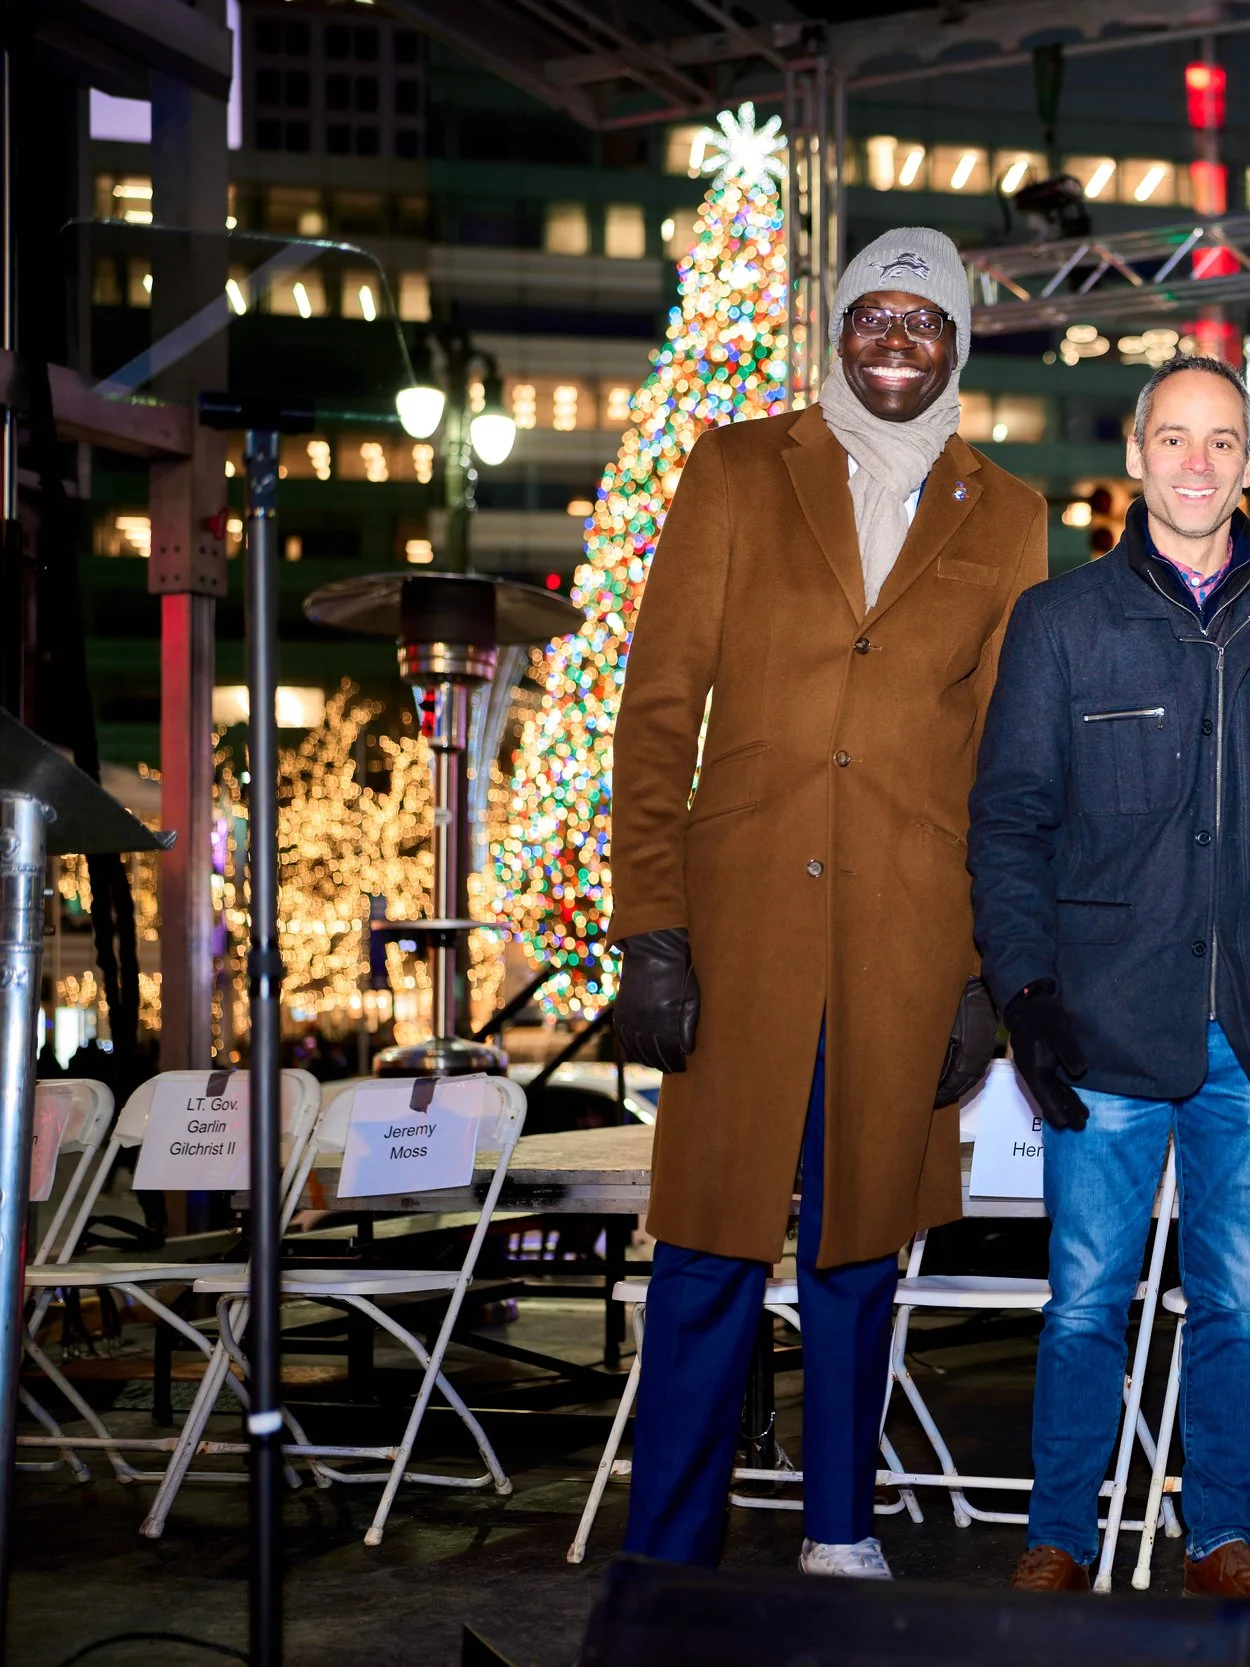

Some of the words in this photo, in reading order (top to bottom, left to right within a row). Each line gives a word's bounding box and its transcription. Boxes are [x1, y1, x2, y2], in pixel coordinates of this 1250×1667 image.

[187, 1097, 206, 1111] LT.
[211, 1097, 238, 1111] Gov.
[187, 1119, 226, 1133] Garlin
[383, 1123, 437, 1139] Jeremy
[170, 1141, 223, 1156] Gilchrist
[227, 1141, 236, 1155] II
[390, 1146, 428, 1160] Moss
